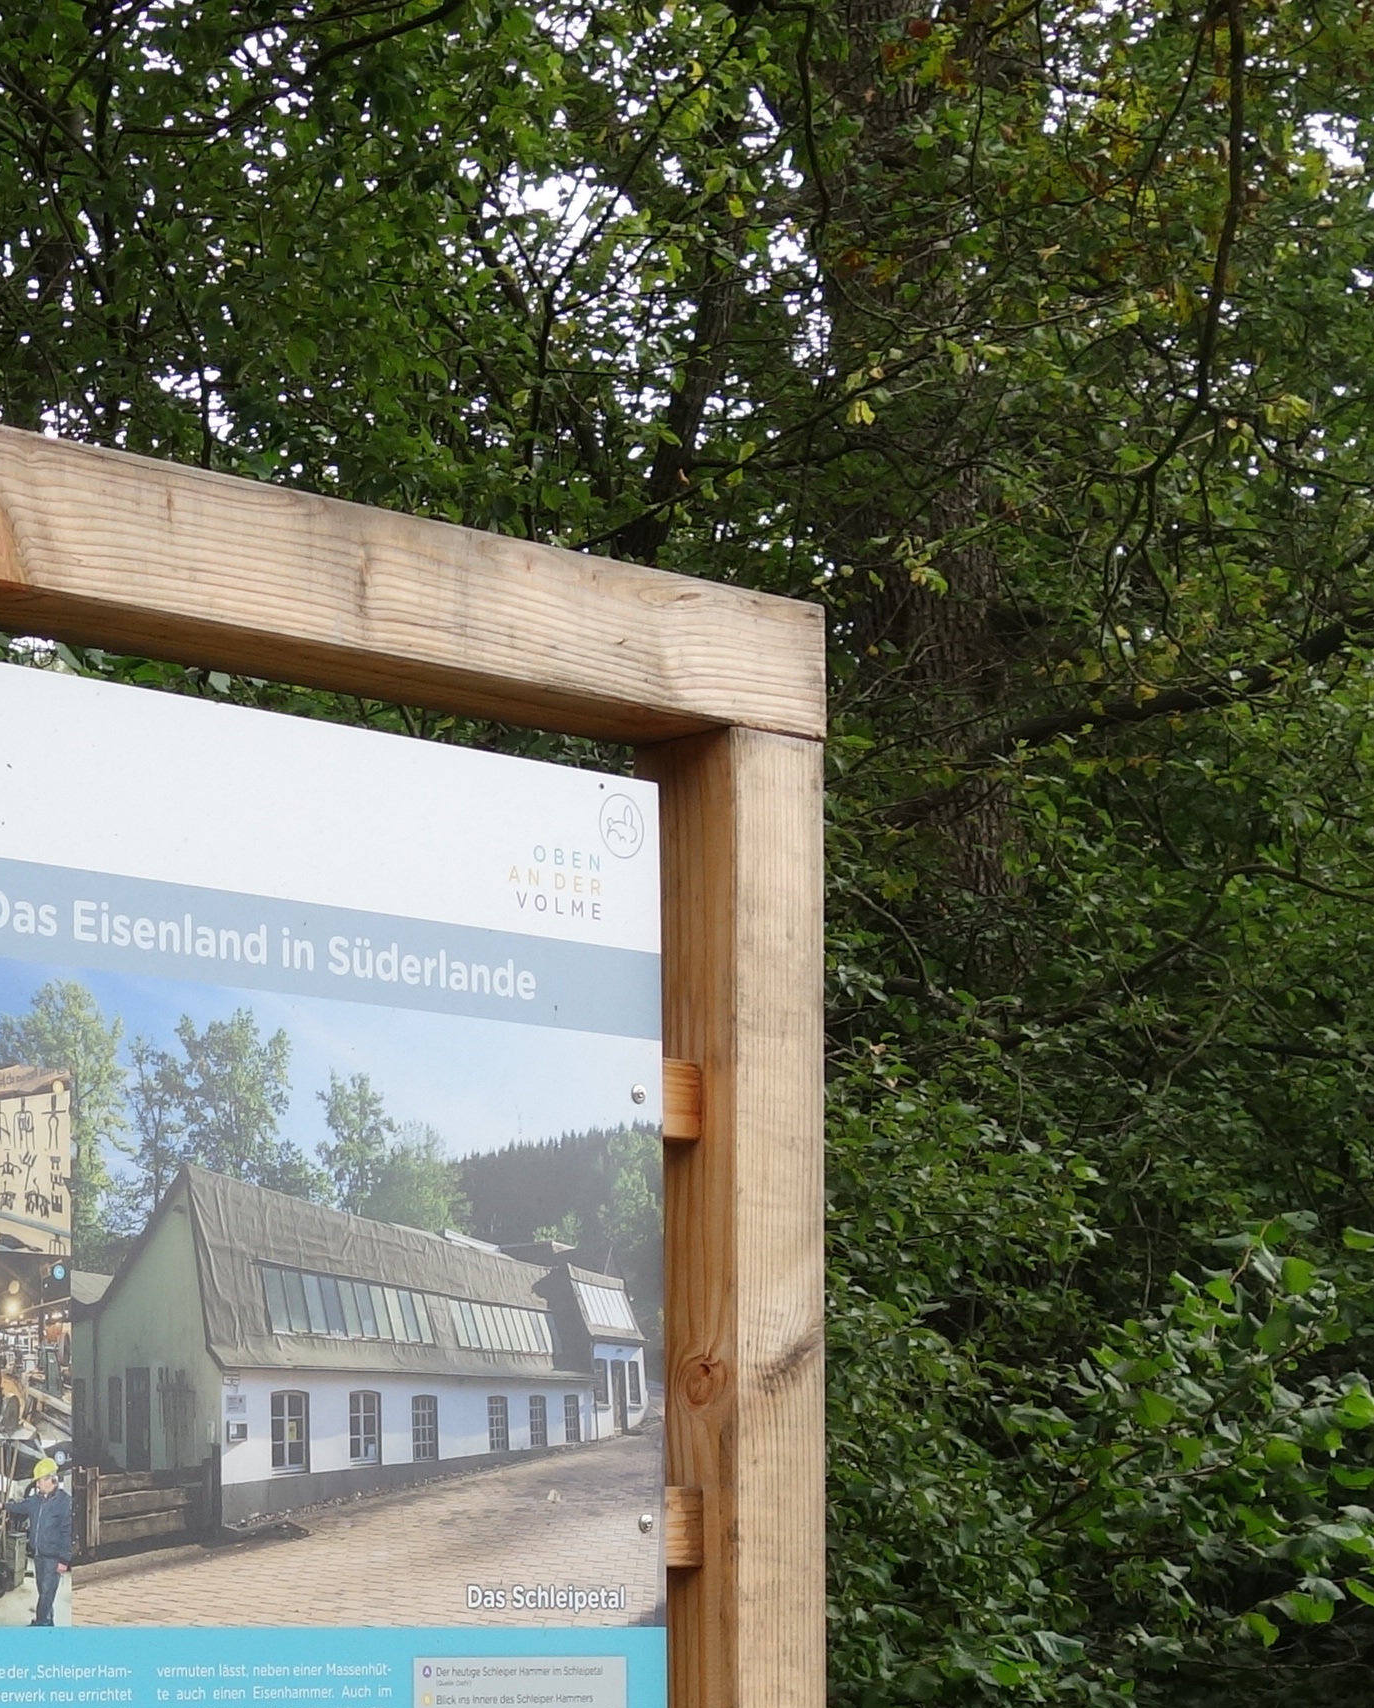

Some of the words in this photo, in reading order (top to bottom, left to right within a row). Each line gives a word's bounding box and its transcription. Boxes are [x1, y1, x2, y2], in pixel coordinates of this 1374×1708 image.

[533, 845, 600, 872] OBEN
[509, 866, 540, 887] AN
[555, 873, 601, 896] DER
[517, 891, 601, 920] VOLME
[74, 900, 267, 964] Eisenland
[282, 924, 314, 971] in
[328, 936, 536, 1000] Süderlande
[467, 1583, 506, 1609] Das
[511, 1584, 625, 1614] Schleipetal
[7, 1665, 29, 1678] der
[97, 1665, 132, 1677] Ham-
[51, 1692, 73, 1701] neu
[78, 1688, 132, 1701] errichtet
